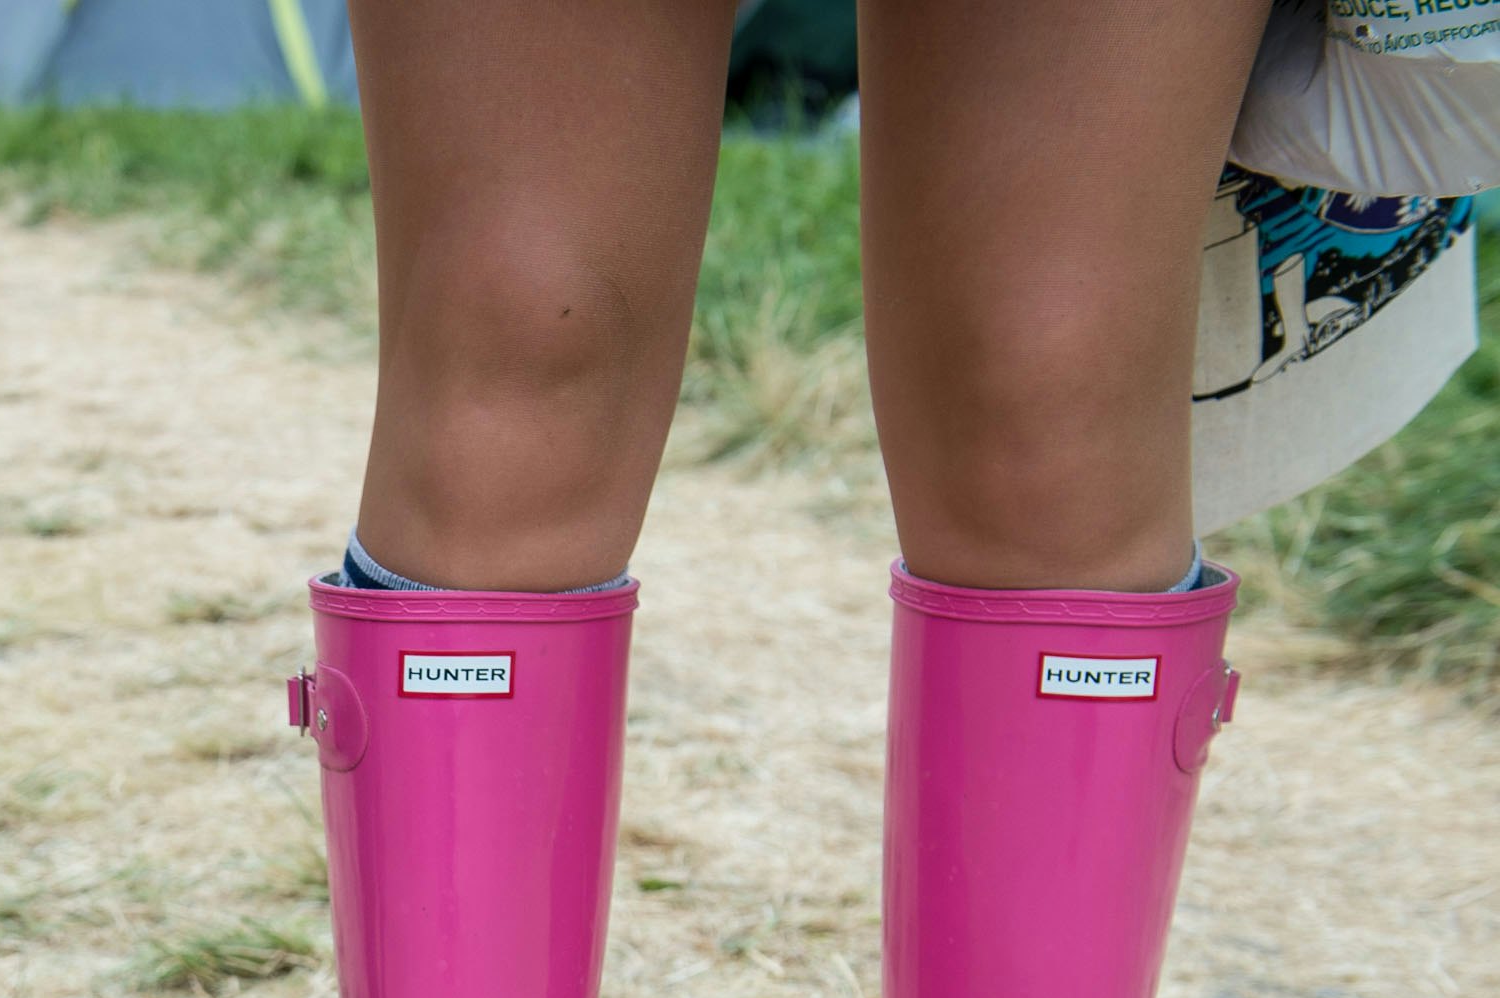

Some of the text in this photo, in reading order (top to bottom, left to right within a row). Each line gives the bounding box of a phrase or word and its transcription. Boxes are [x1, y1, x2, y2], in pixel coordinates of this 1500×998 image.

[1384, 32, 1422, 53] AVOID
[407, 667, 506, 681] HUNTER
[1047, 668, 1151, 684] HUNTER
